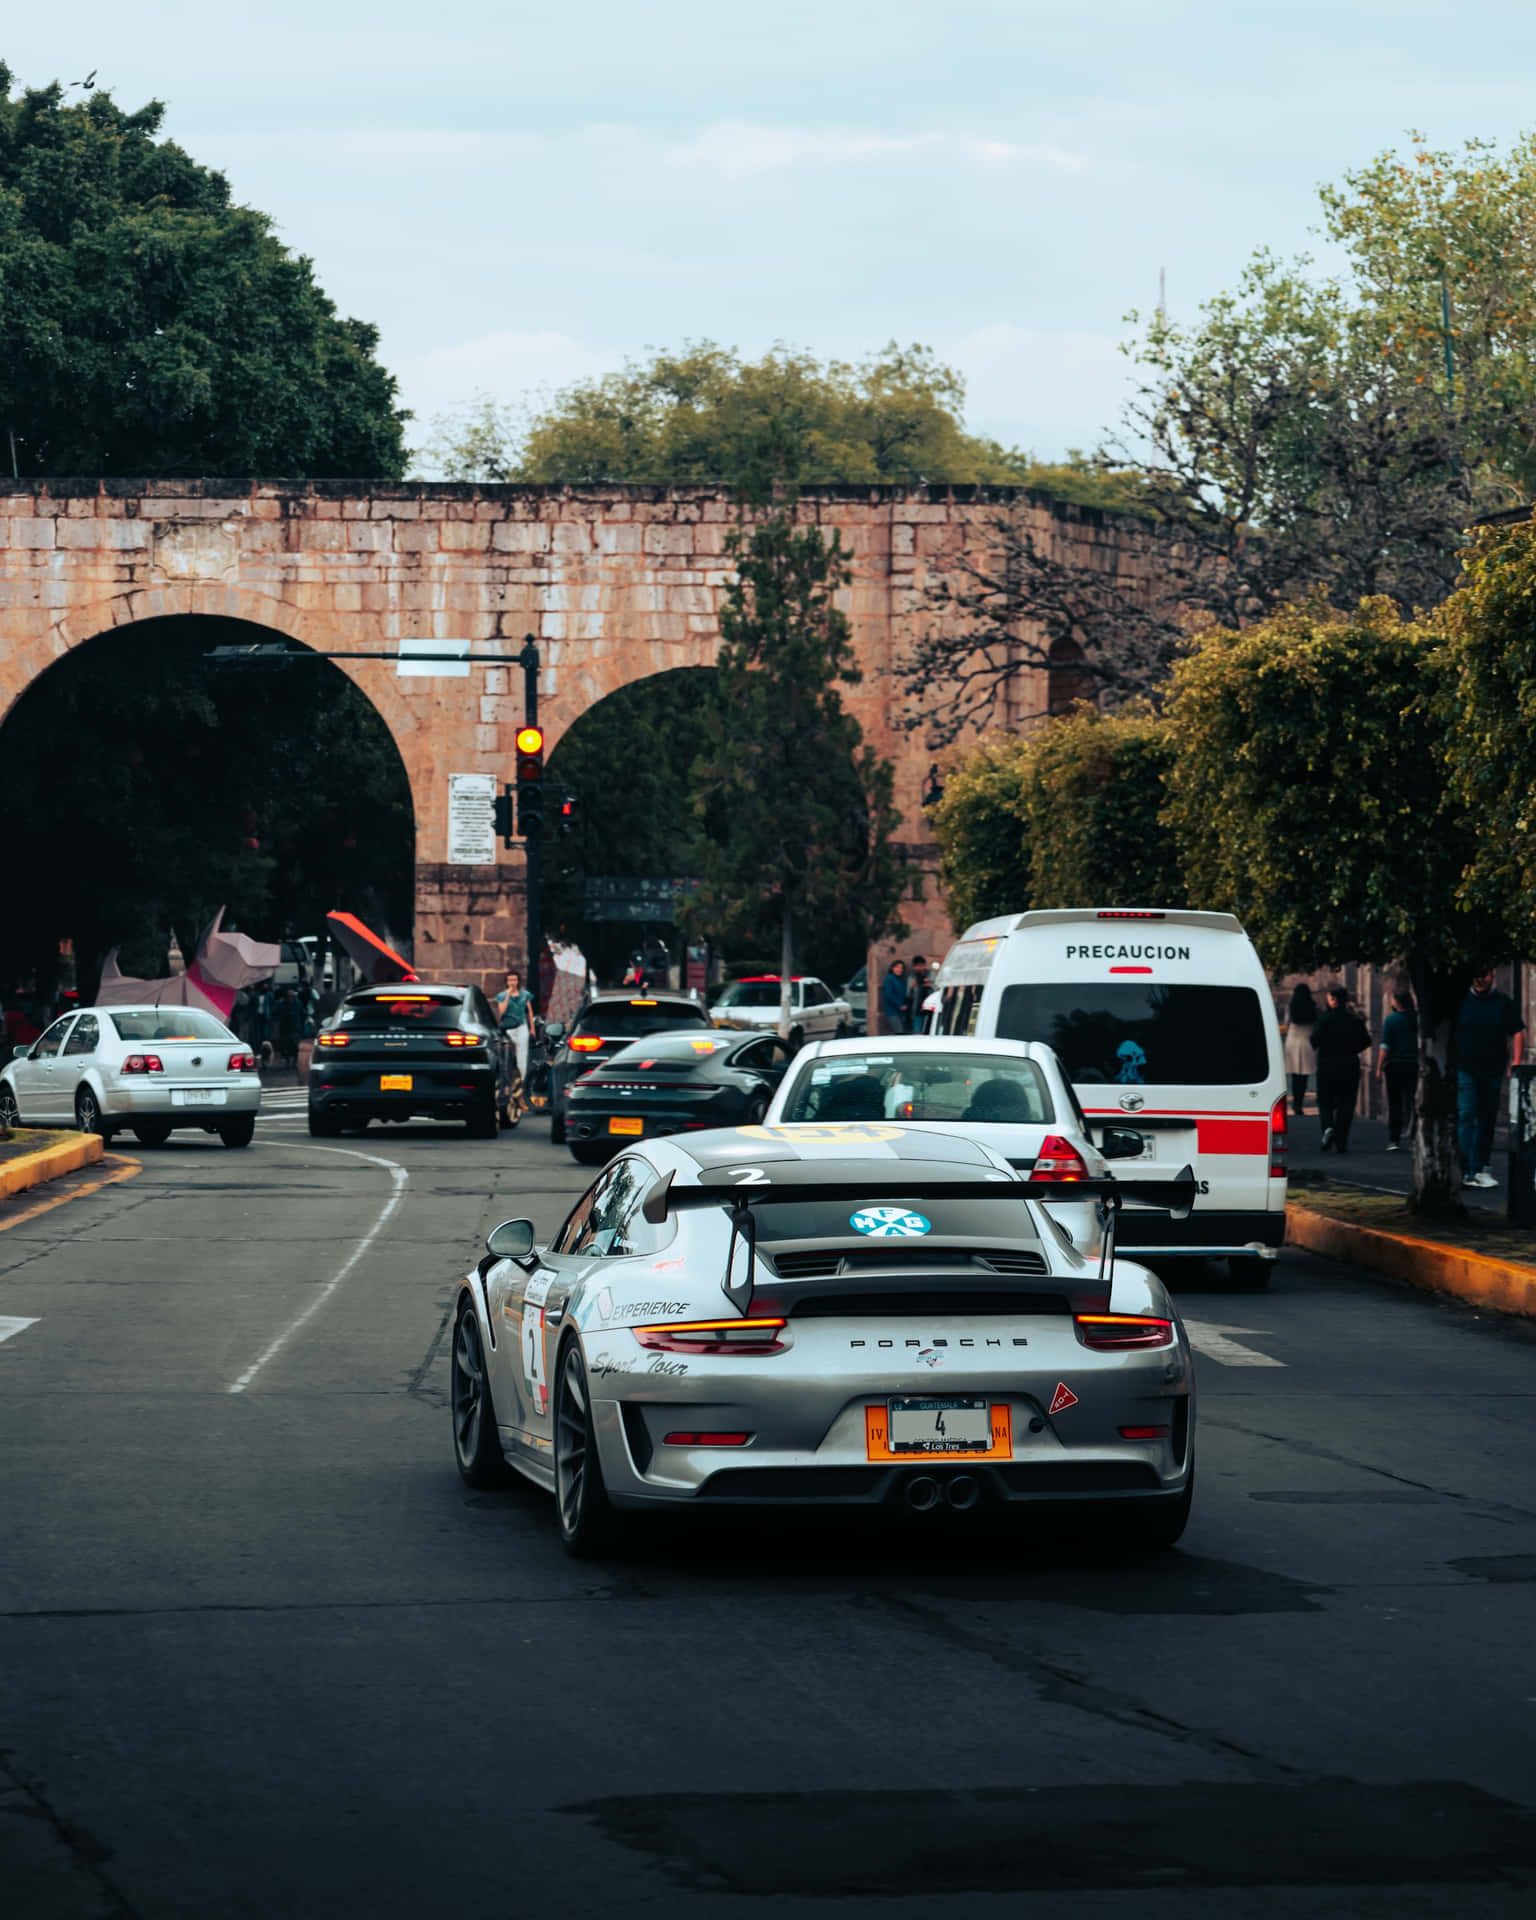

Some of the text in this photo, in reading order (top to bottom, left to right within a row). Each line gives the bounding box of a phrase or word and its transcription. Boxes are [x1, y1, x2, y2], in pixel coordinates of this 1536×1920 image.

[1066, 945, 1190, 960] PRECAUCION
[728, 1168, 771, 1185] 2
[612, 1302, 690, 1320] EXPERIENCE
[850, 1338, 1028, 1348] PORSCHE
[647, 1352, 688, 1377] Tour
[935, 1411, 946, 1436] 4
[992, 1426, 1007, 1439] NA
[931, 1442, 944, 1450] Los
[945, 1442, 960, 1450] Tres
